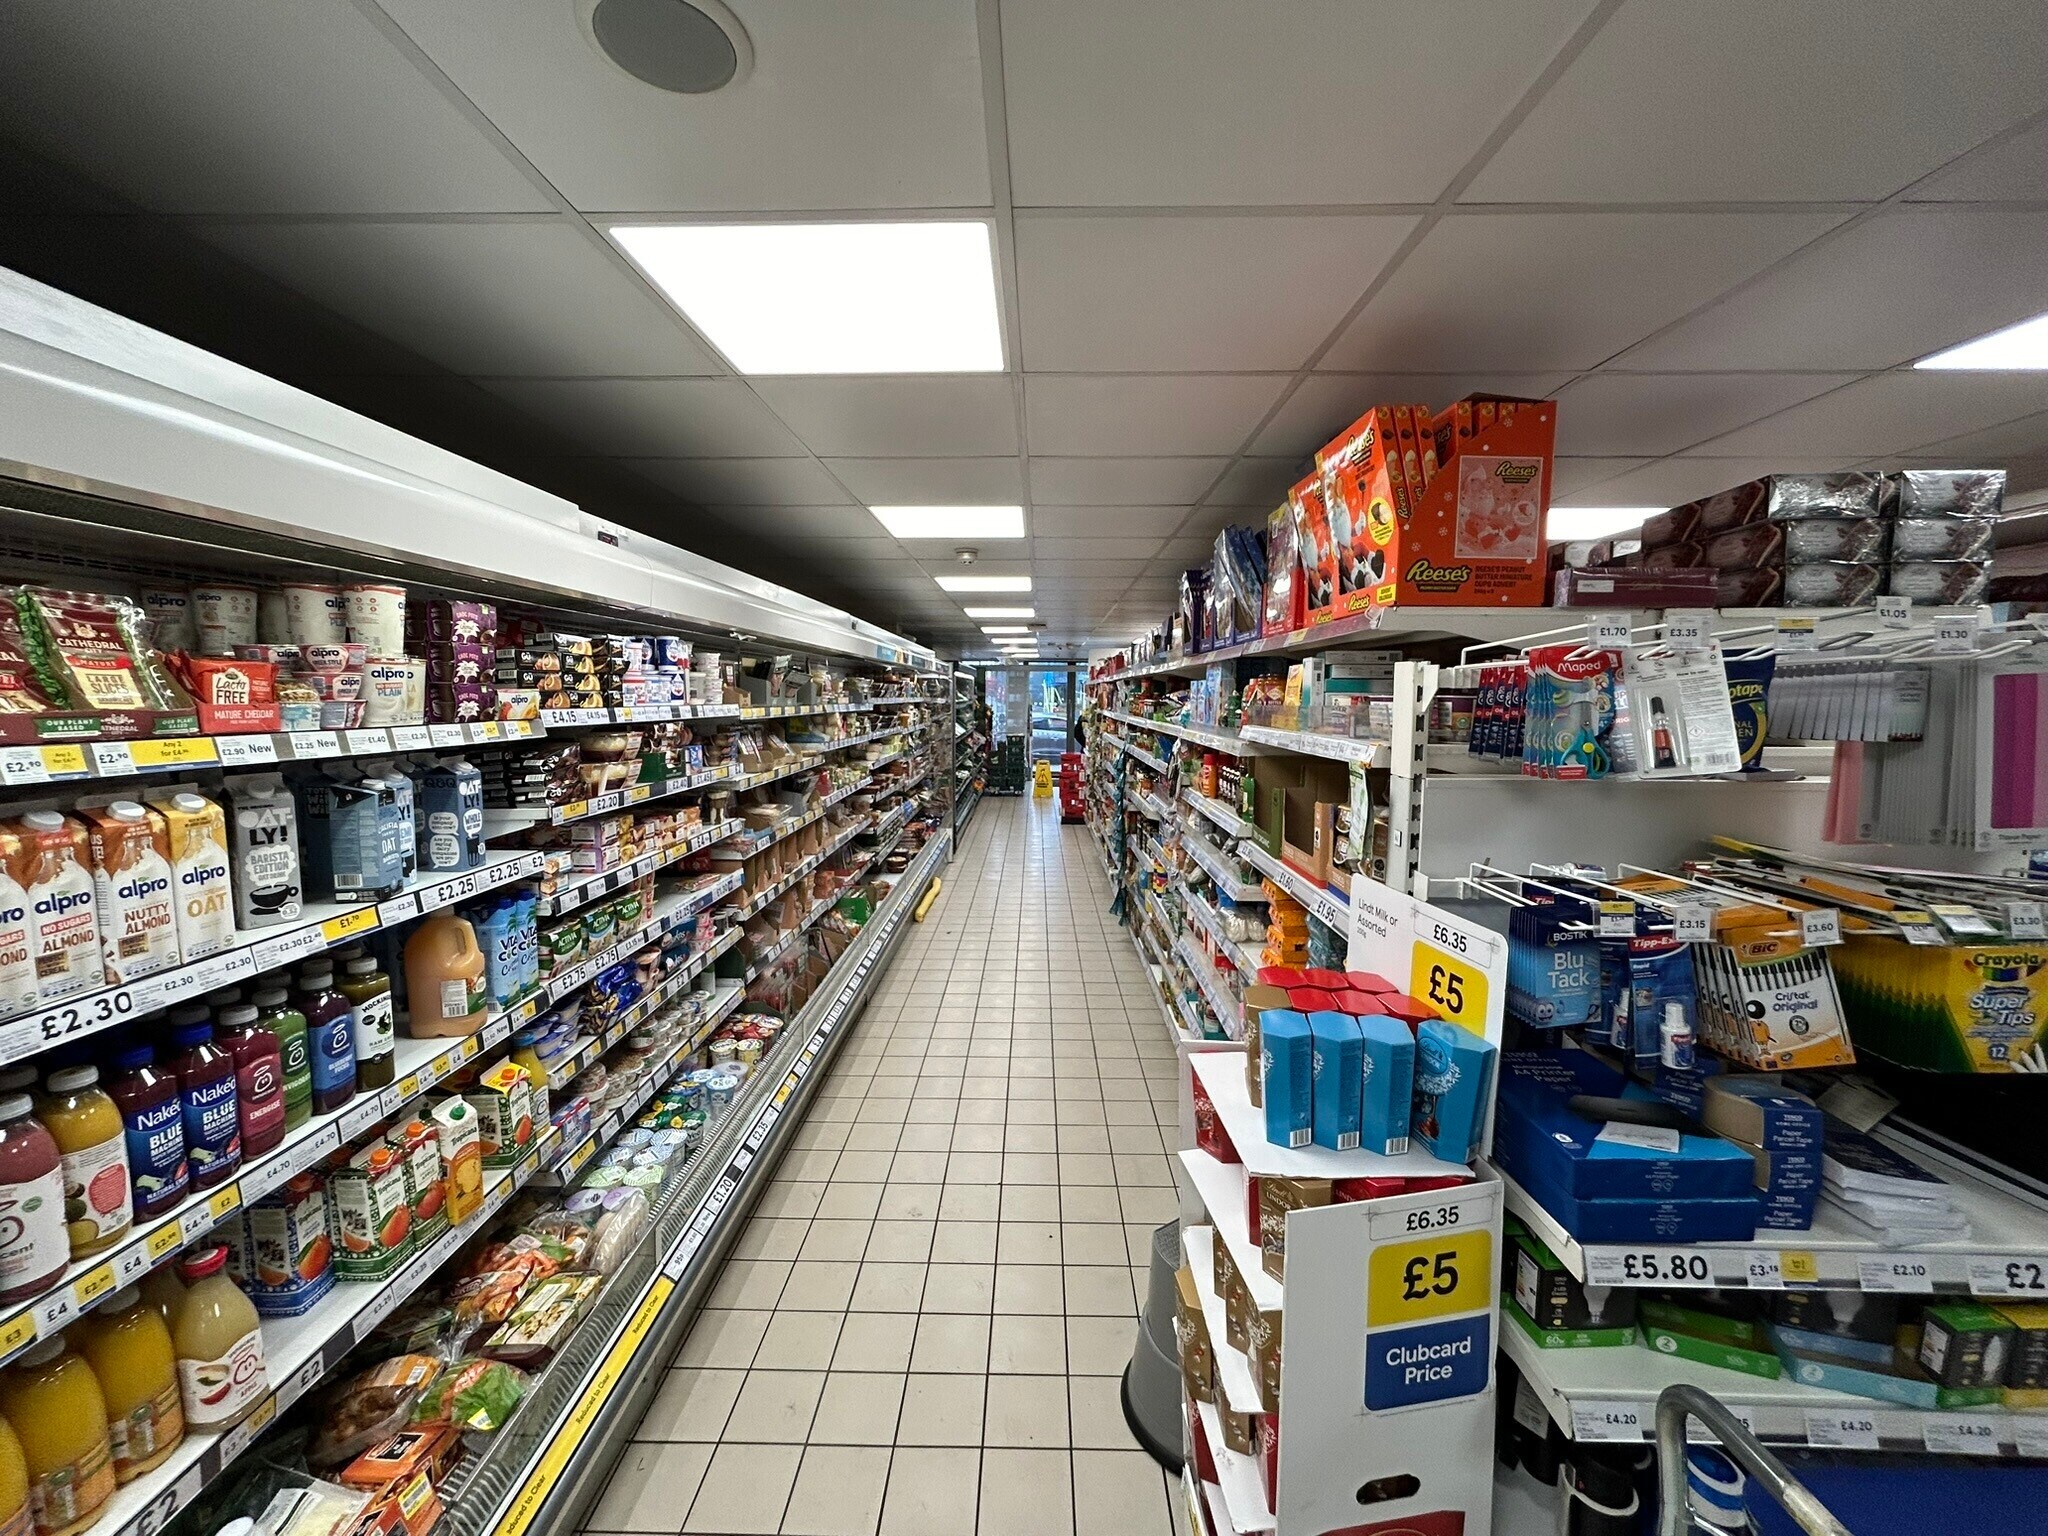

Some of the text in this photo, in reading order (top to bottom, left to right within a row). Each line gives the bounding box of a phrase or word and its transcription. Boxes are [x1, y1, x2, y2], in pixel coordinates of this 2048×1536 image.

[1496, 462, 1538, 476] Reese's
[1407, 559, 1471, 581] Reese's
[1880, 609, 1907, 619] £1.05
[1600, 627, 1627, 636] £1.70
[1670, 628, 1698, 637] £3.35
[1941, 630, 1967, 639] £1.30
[57, 637, 123, 651] CATHEDRAL
[311, 648, 339, 659] alpro
[371, 668, 405, 681] alpro
[1558, 660, 1601, 673] Maped
[215, 677, 246, 690] Lacto
[216, 688, 246, 704] FREE
[511, 695, 528, 705] alpro
[552, 709, 577, 724] £4.15
[294, 738, 337, 750] £2.25 New
[368, 735, 386, 744] £1.40
[100, 752, 128, 764] £2.90
[221, 743, 272, 756] £2.90 New
[6, 760, 42, 773] £2.90
[597, 796, 618, 810] £2.20
[249, 825, 289, 846] LY!
[382, 836, 397, 854] OAT
[250, 853, 290, 866] BARISTA
[254, 862, 290, 875] EDITION
[182, 864, 226, 886] alpro
[489, 862, 520, 884] £2.25
[1278, 872, 1294, 890] £1.60
[118, 876, 168, 899] alpro
[438, 874, 474, 903] £2.25
[34, 890, 92, 915] alpro
[187, 892, 228, 918] OAT
[398, 900, 414, 911] £2.30
[124, 902, 169, 923] NUTTY
[339, 914, 360, 928] £1.70
[1316, 900, 1336, 925] £1.95
[1358, 898, 1398, 927] Lindt Milk or
[42, 914, 92, 935] NO SUGARS
[125, 914, 171, 936] ALMOND
[1357, 914, 1387, 938] Assorted
[1679, 920, 1706, 929] £3.15
[1807, 923, 1834, 932] £3.60
[43, 929, 94, 953] ALMOND
[1433, 923, 1468, 953] £6.35
[1554, 930, 1589, 942] BOSTIK
[279, 939, 302, 952] £2.30
[225, 956, 251, 972] £2.30
[595, 950, 617, 969] £2.75
[1555, 952, 1584, 970] Blu
[1973, 953, 2039, 968] Crayola
[164, 975, 194, 992] £2.30
[562, 970, 586, 990] £2.75
[1547, 968, 1590, 988] Tack
[1429, 964, 1464, 1014] £5
[1772, 1000, 1818, 1014] Original
[1970, 994, 2026, 1011] Super
[41, 991, 134, 1041] £2.30
[1998, 1011, 2035, 1027] Tips
[496, 1024, 508, 1036] New
[1991, 1047, 2005, 1058] 12
[192, 1077, 237, 1106] Naked
[203, 1099, 236, 1123] BLUE
[250, 1100, 281, 1122] ENERGISE
[360, 1105, 380, 1121] £4.70
[203, 1112, 236, 1132] MACHINE
[149, 1121, 182, 1144] BLUE
[314, 1132, 336, 1149] £4.70
[452, 1126, 477, 1147] Tropicana
[751, 1121, 769, 1142] £2.35
[150, 1135, 183, 1155] MACHINE
[266, 1160, 291, 1179] £4.70
[415, 1153, 436, 1170] Tropicana
[377, 1174, 402, 1196] Tropicana
[712, 1178, 733, 1204] £1.20
[1406, 1205, 1459, 1231] £6.35
[123, 1259, 142, 1275] £4
[1402, 1250, 1459, 1302] £5
[1623, 1254, 1708, 1281] £5.80
[1750, 1264, 1779, 1276] £3.15
[1893, 1264, 1926, 1276] £2.10
[2006, 1262, 2046, 1289] £2
[47, 1304, 68, 1322] £4
[5, 1328, 22, 1344] £3
[1386, 1336, 1472, 1366] Clubcard
[300, 1361, 321, 1386] £2
[1405, 1364, 1453, 1384] Price
[576, 1372, 611, 1425] Reduced to Clear
[1606, 1414, 1637, 1425] £4.20
[1841, 1421, 1873, 1431] £4.20
[1958, 1426, 1992, 1436] £4.20
[525, 1493, 534, 1506] to
[530, 1474, 547, 1498] Clear
[136, 1488, 180, 1536] £2
